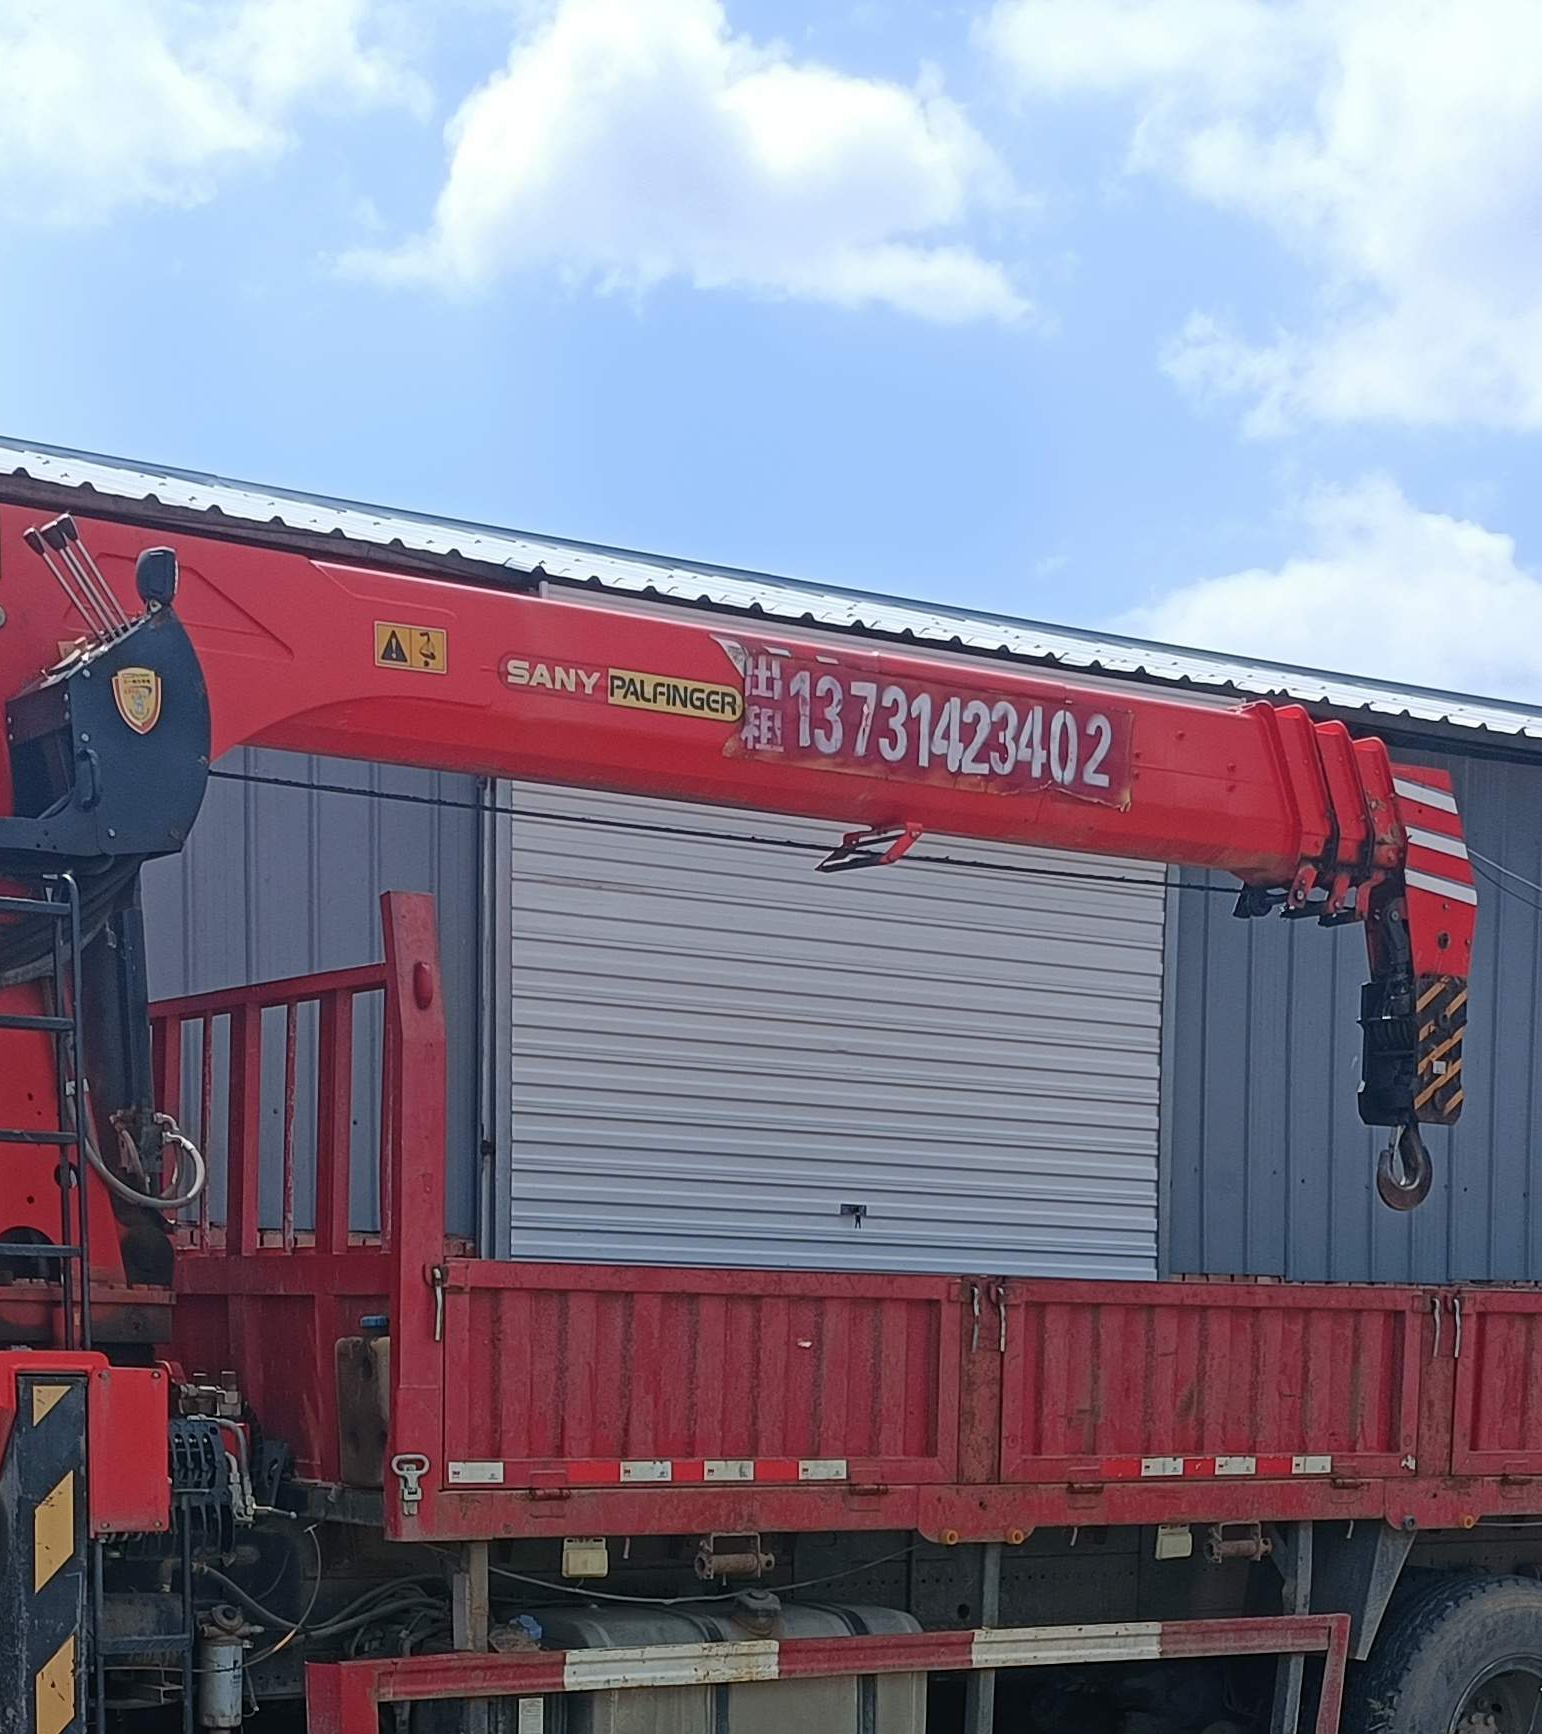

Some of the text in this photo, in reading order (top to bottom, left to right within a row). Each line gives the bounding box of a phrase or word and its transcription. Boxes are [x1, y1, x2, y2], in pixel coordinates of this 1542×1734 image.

[507, 659, 600, 695] SANY
[609, 675, 738, 716] PALFINGER
[740, 654, 785, 753] 出租
[789, 670, 1112, 788] 13731423402
